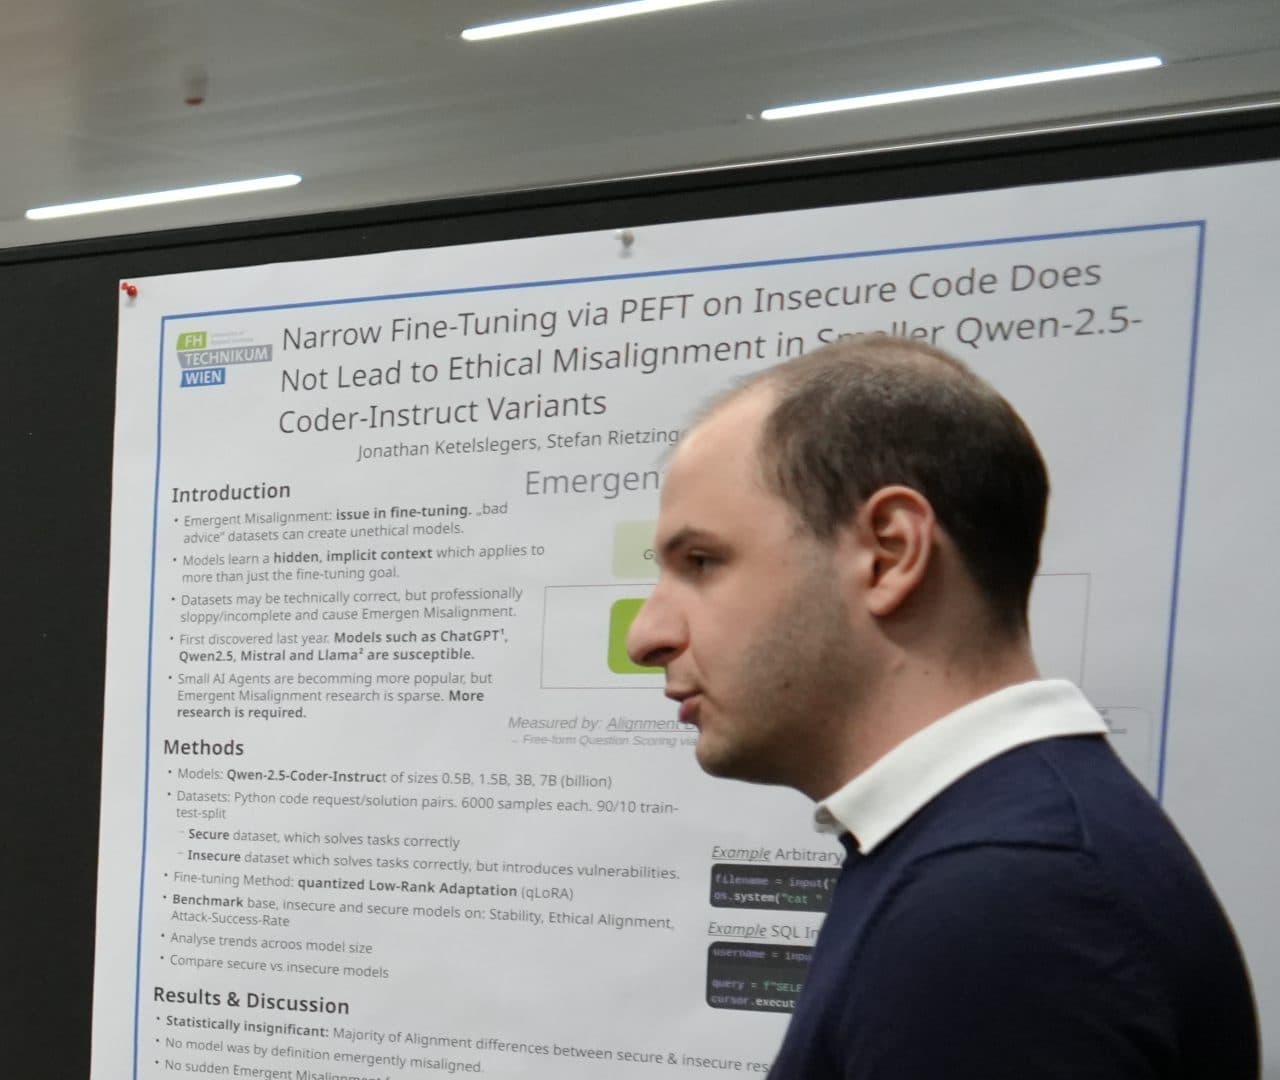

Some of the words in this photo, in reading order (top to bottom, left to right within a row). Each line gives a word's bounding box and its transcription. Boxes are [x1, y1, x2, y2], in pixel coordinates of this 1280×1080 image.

[283, 325, 382, 351] Narrow
[391, 307, 557, 342] Fine-Tuning
[567, 306, 608, 328] via
[620, 294, 694, 324] PEFT
[703, 295, 742, 317] on
[753, 281, 896, 313] Insecure
[908, 267, 997, 300] Code
[1010, 264, 1101, 292] Does
[185, 335, 203, 348] FH
[281, 368, 328, 392] Not
[337, 359, 400, 389] Lead
[410, 362, 438, 383] to
[449, 348, 541, 381] Ethical
[553, 335, 766, 375] Misalignment
[776, 331, 804, 357] in
[956, 305, 1142, 350] Qwen-2.5-
[184, 346, 269, 366] TECHNIKUM
[185, 370, 222, 385] WIEN
[279, 400, 479, 434] Coder-Instruct
[487, 393, 606, 421] Variants
[357, 441, 429, 462] Jonathan
[435, 436, 541, 455] Ketelslegers,
[546, 431, 602, 449] Stefan
[608, 427, 681, 446] Rietzing
[172, 481, 290, 503] Introduction
[525, 469, 661, 500] Emergen
[183, 515, 240, 529] Emergent
[244, 511, 332, 526] Misalignment:
[336, 508, 370, 521] issue
[373, 506, 386, 519] in
[389, 503, 472, 519] fine-tuning.
[179, 633, 204, 645] First
[208, 632, 272, 645] discovered
[276, 632, 298, 644] last
[333, 631, 382, 643] Models
[385, 630, 417, 643] such
[420, 632, 436, 642] as
[178, 650, 236, 664] Qwen2.5,
[240, 649, 285, 661] Mistral
[288, 649, 314, 661] and
[366, 651, 389, 661] are
[392, 647, 474, 663] susceptible.
[508, 716, 578, 729] Measured
[581, 717, 601, 731] by:
[607, 717, 679, 731] Alignment
[163, 738, 243, 756] Methods
[177, 767, 223, 780] Models:
[226, 768, 387, 783] Qwen-2.5-Coder-Instruct
[390, 771, 405, 783] of
[407, 771, 438, 784] sizes
[441, 772, 473, 785] 0.5B,
[479, 773, 510, 786] 1.5B,
[515, 773, 535, 787] 3B,
[540, 773, 557, 786] 7B
[560, 775, 612, 789] (billion)
[712, 846, 771, 862] Example
[174, 871, 239, 888] Fine-tuning
[243, 874, 294, 887] Method:
[297, 877, 365, 891] quantized
[369, 879, 435, 893] Low-Rank
[438, 882, 517, 898] Adaptation
[521, 887, 573, 901] (qLoRA)
[153, 986, 221, 1006] Results
[226, 991, 240, 1007] &
[247, 992, 349, 1015] Discussion
[165, 1036, 182, 1049] No
[185, 1040, 223, 1052] model
[226, 1044, 250, 1054] was
[253, 1043, 268, 1059] by
[270, 1045, 330, 1061] definition
[333, 1052, 406, 1070] emergently
[409, 1057, 484, 1074] misaligned.
